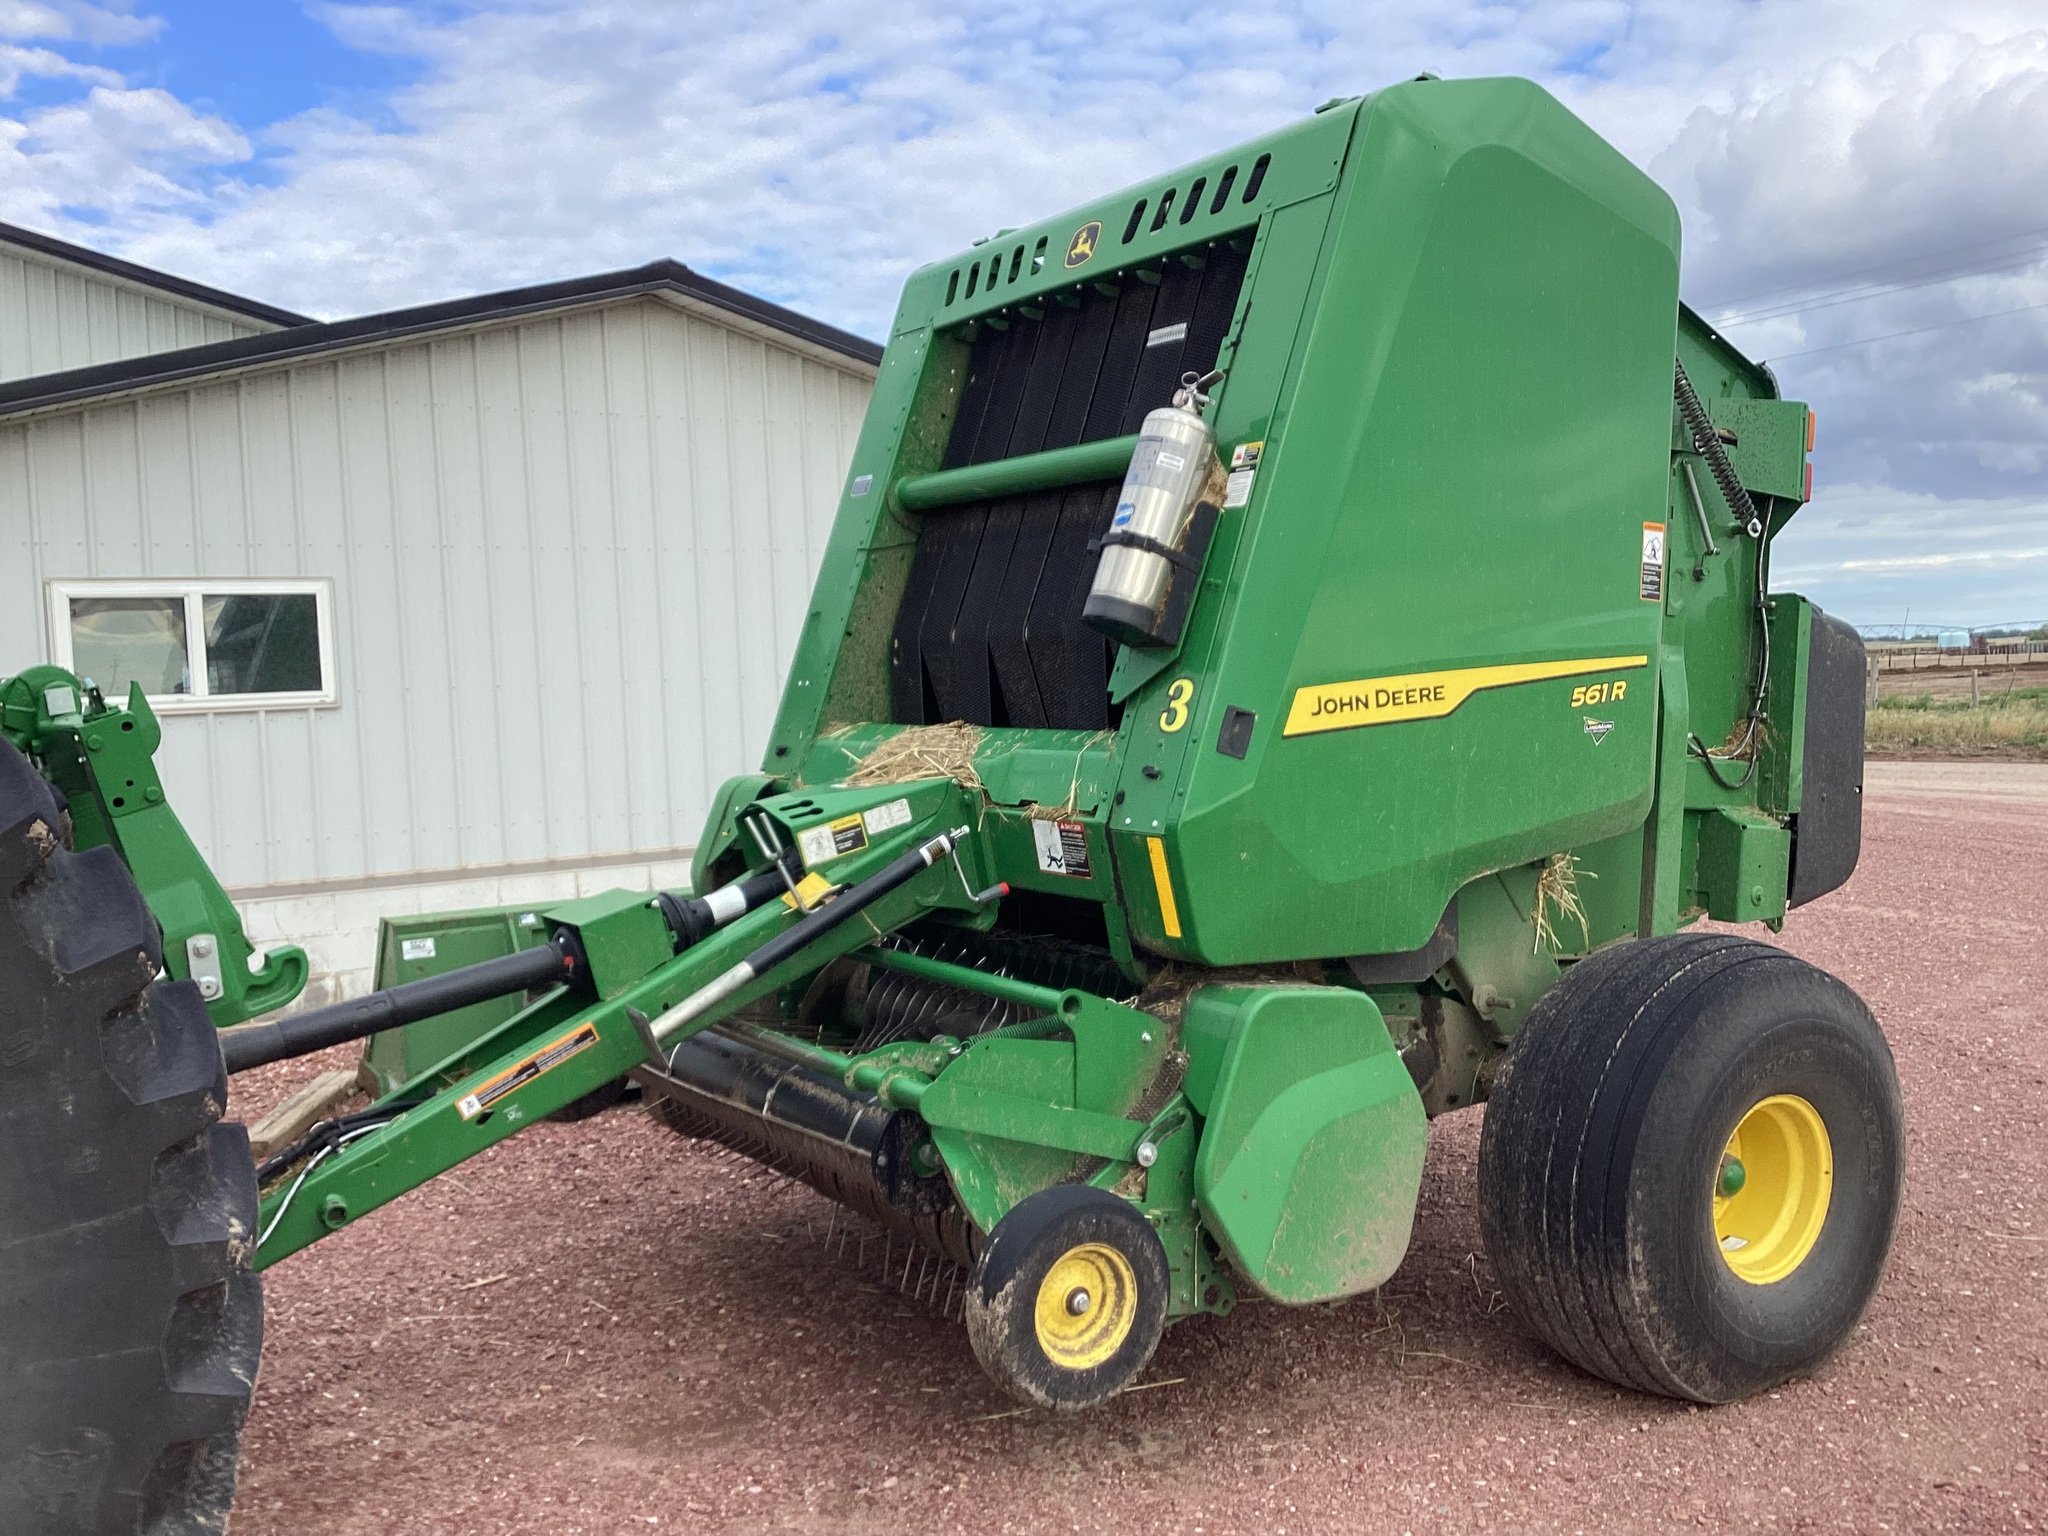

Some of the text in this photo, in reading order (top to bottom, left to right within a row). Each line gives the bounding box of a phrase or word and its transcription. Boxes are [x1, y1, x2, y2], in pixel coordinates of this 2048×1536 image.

[1159, 678, 1194, 733] 3
[1311, 685, 1446, 716] JOHN DEERE
